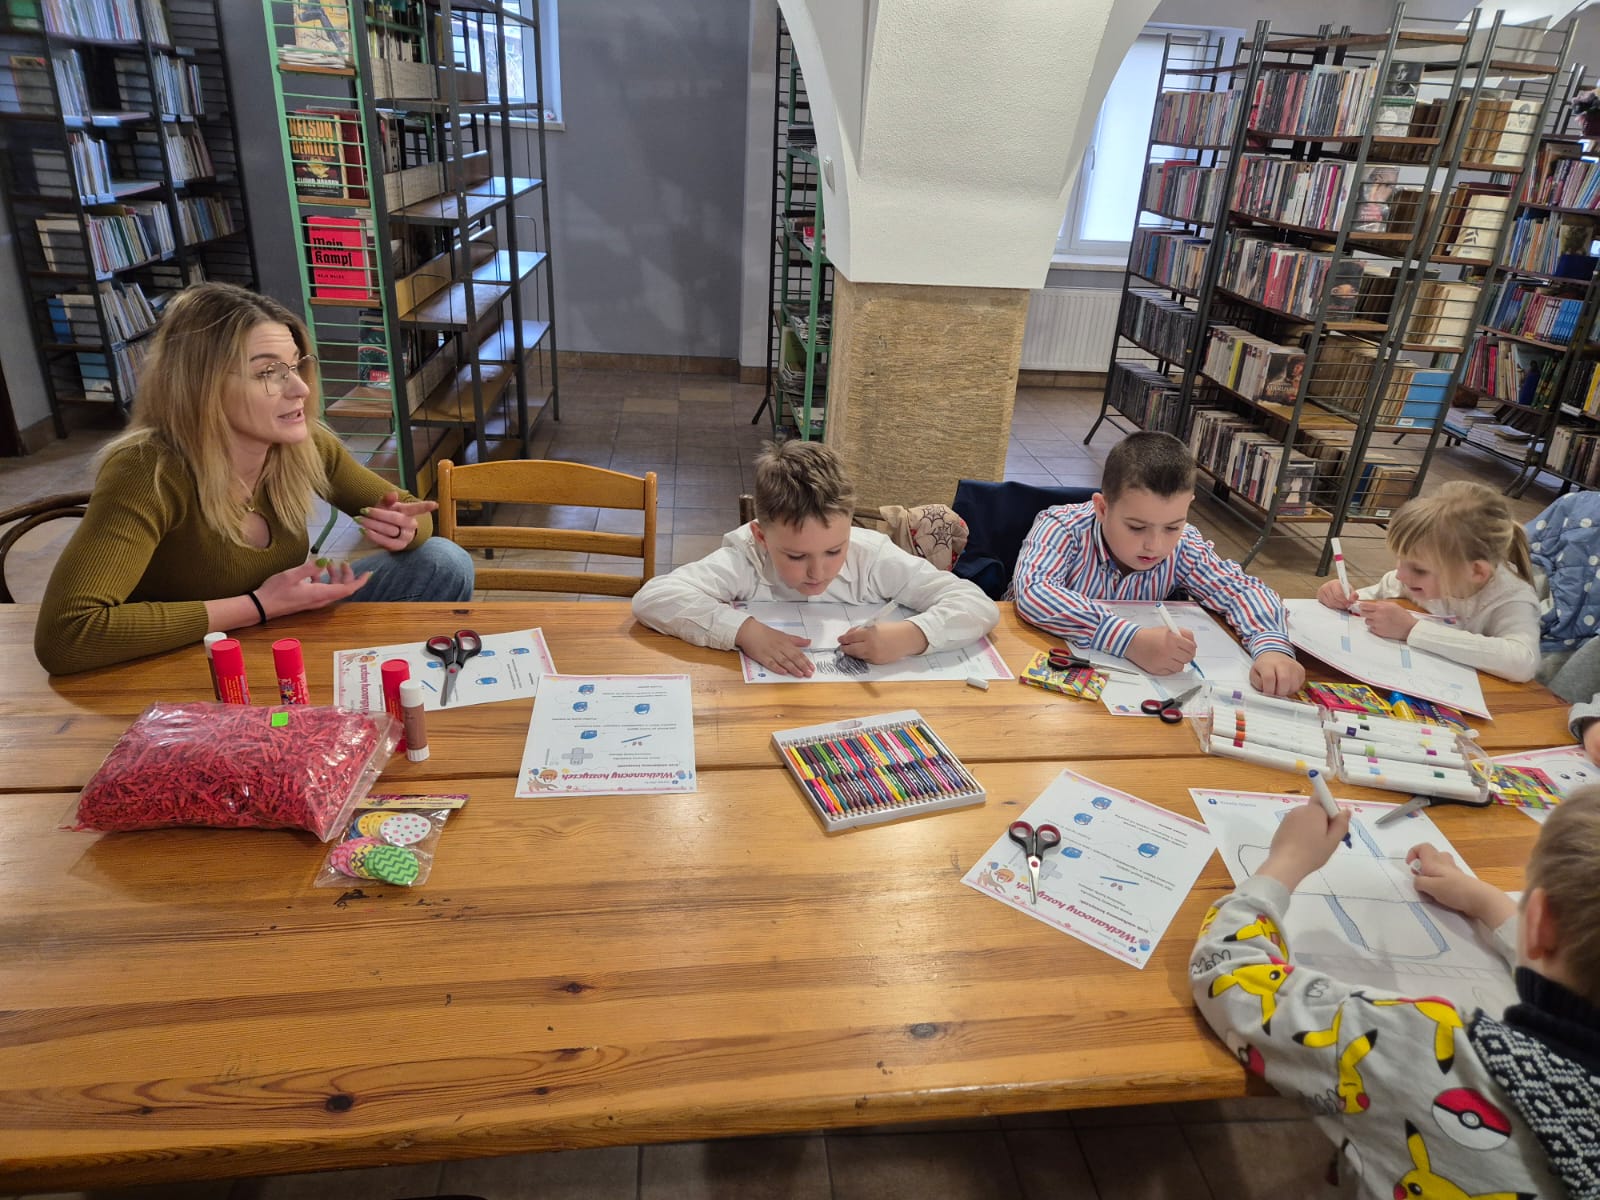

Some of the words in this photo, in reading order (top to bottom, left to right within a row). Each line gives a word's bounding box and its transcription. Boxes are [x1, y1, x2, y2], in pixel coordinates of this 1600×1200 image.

[288, 117, 334, 138] NELSON
[290, 137, 336, 156] DEMILLE
[314, 250, 353, 268] Kampf
[1066, 904, 1138, 944] Wielkanocny
